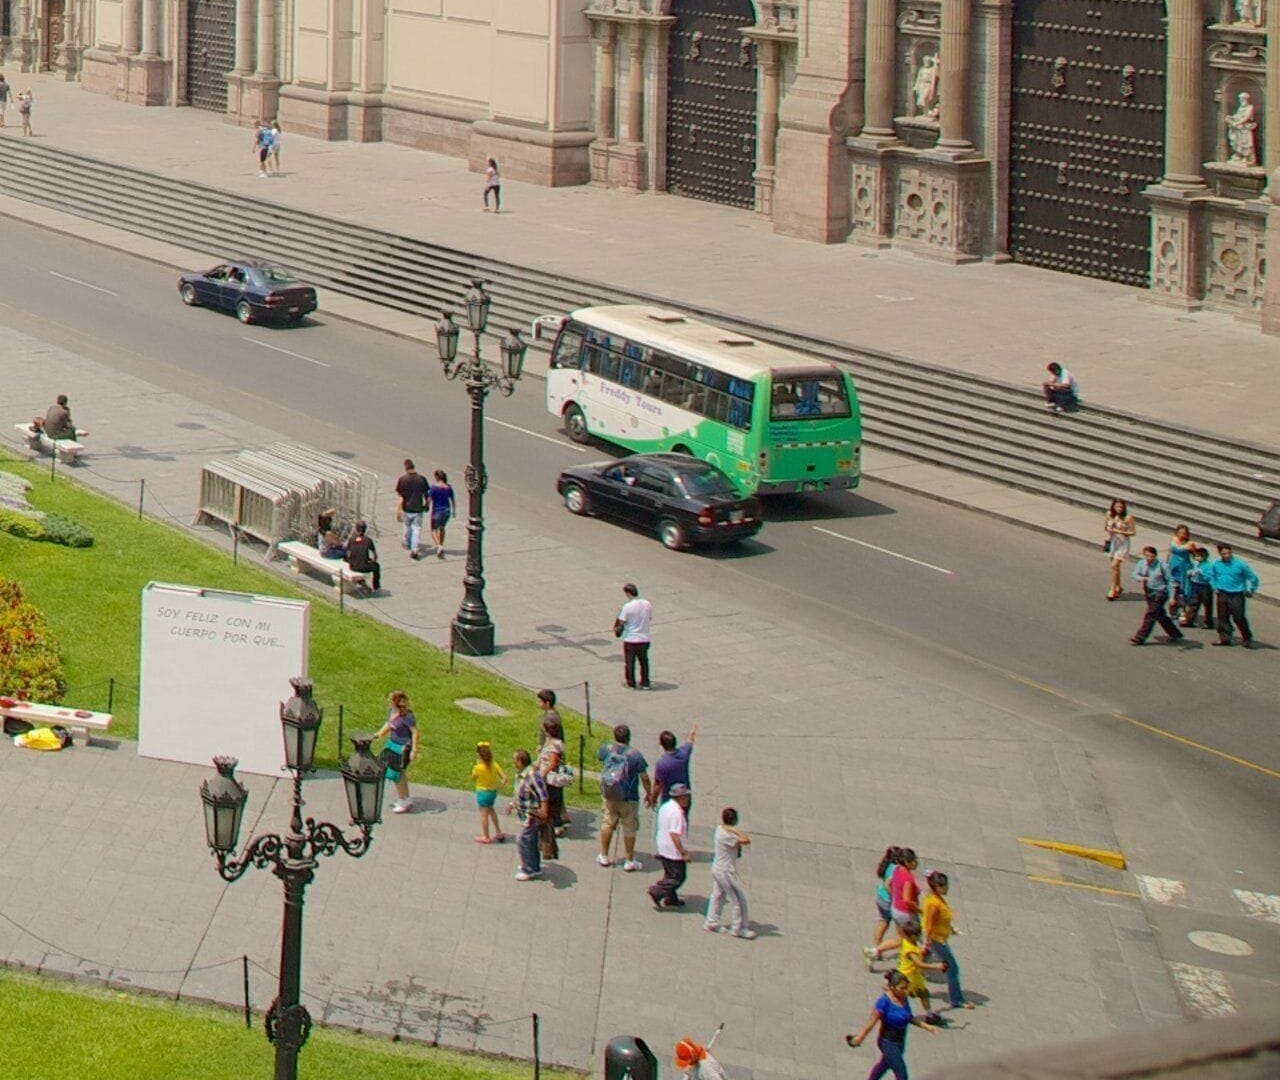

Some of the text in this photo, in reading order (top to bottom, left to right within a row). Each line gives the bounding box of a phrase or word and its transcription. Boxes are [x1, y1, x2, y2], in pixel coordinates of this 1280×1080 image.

[600, 381, 662, 416] Freddy Tours
[156, 607, 272, 632] SOY FELIZ CON MI
[170, 626, 217, 641] CUERPO
[223, 631, 248, 644] POR
